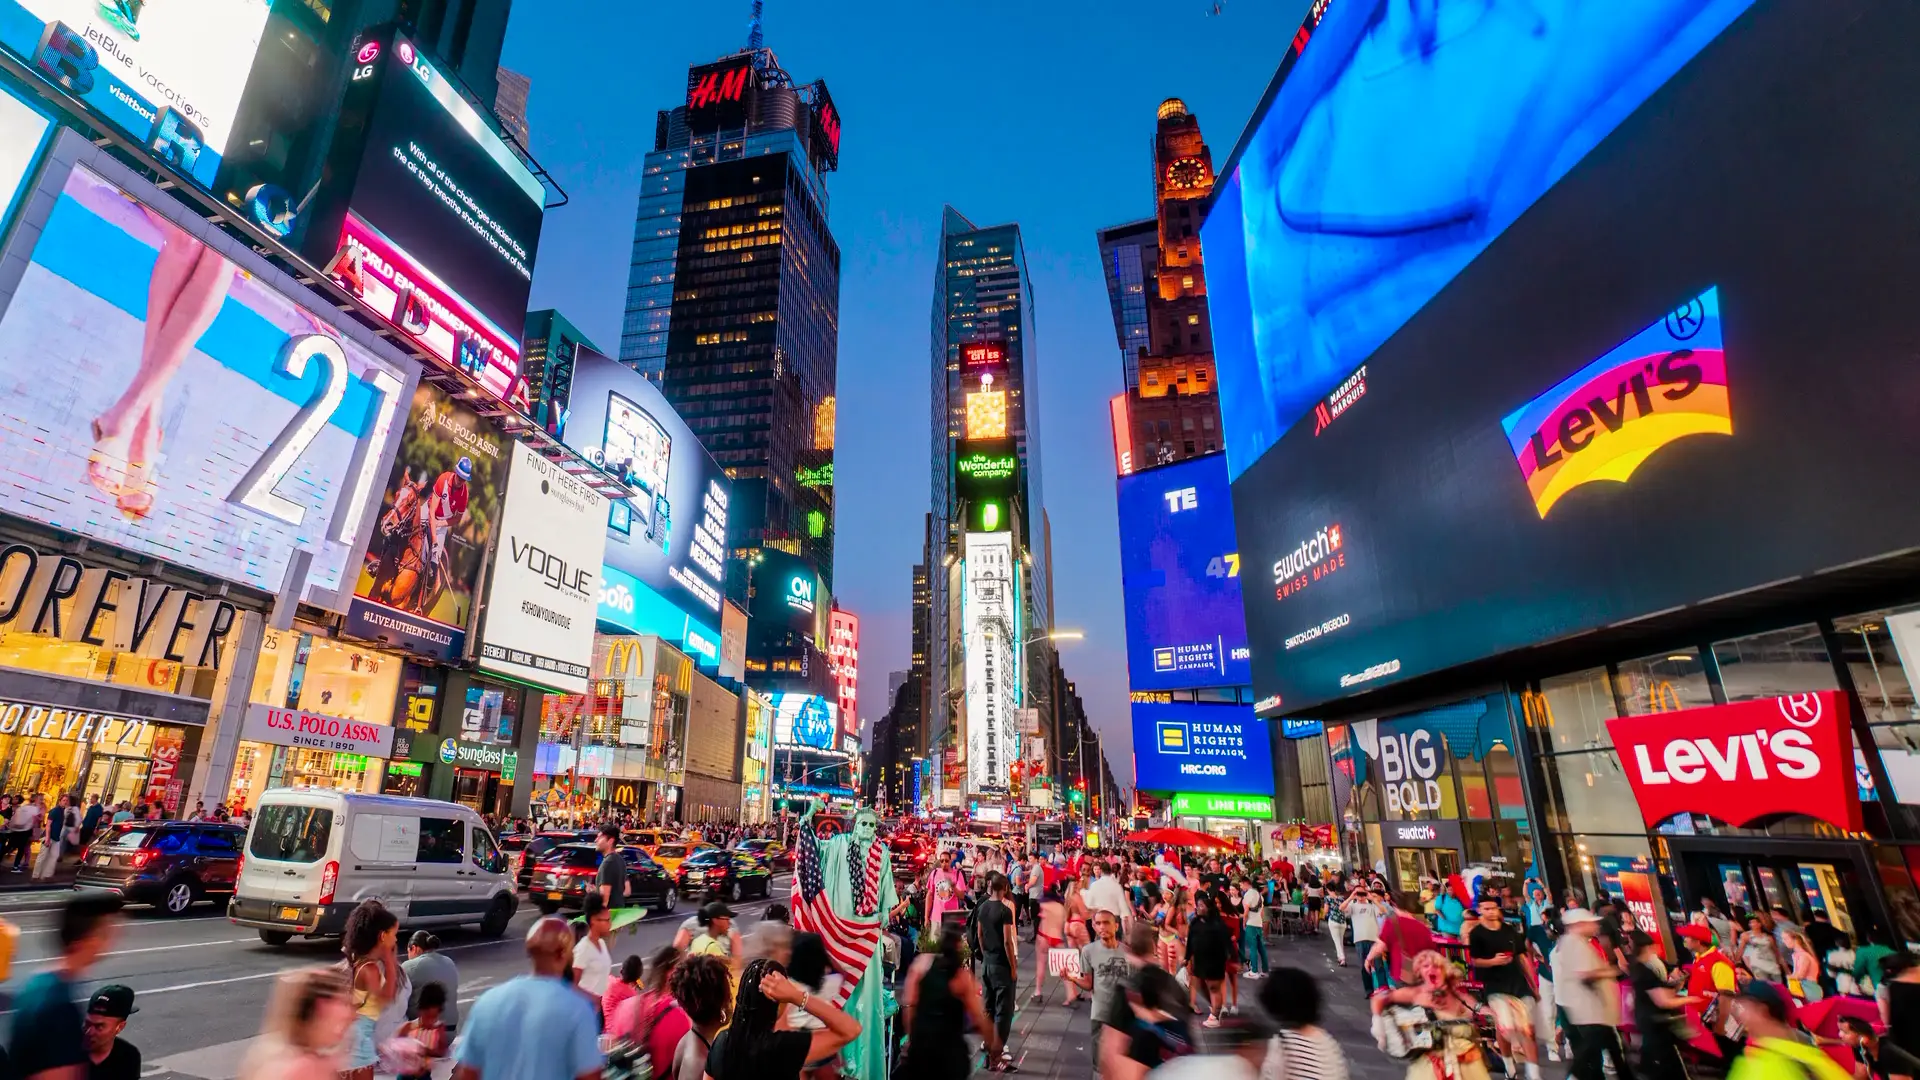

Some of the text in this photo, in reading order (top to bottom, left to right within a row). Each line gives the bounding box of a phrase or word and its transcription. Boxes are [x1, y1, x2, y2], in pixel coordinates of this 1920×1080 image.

[82, 22, 210, 128] jetBlue vacations
[353, 65, 374, 81] LG
[412, 56, 430, 82] LG
[689, 65, 748, 109] H&M
[820, 102, 840, 155] H&M
[394, 146, 408, 166] the
[407, 159, 420, 176] air
[417, 168, 435, 192] they
[434, 182, 462, 216] breathe
[460, 209, 491, 241] shouldn't
[488, 234, 499, 251] be
[497, 244, 512, 261] one
[509, 253, 519, 266] of
[409, 141, 528, 261] With all of the challenges children face,
[1330, 366, 1367, 405] MARRIOTT
[1332, 382, 1366, 418] MARQUIS
[241, 334, 404, 548] 21
[438, 412, 500, 460] U.S. POLO ASSN.
[453, 436, 470, 451] SINCE
[960, 457, 1014, 471] Wonderful
[973, 454, 986, 462] the
[526, 453, 601, 508] FIND IT HERE FIRST
[550, 487, 575, 509] sunglass
[1165, 487, 1198, 513] TE
[1205, 553, 1240, 579] 47
[1273, 526, 1331, 585] swatch
[791, 576, 811, 602] ON
[1276, 553, 1345, 601] SWISS MADE
[521, 600, 572, 630] #SHOWYOURVOGUE
[363, 610, 453, 647] #LIVEAUTHENTICALLY
[834, 629, 852, 641] THE
[1285, 613, 1350, 650] SWATCH.COM/BIGBOLD
[263, 635, 278, 649] 25
[483, 644, 506, 660] EYEWEAR
[1177, 643, 1213, 654] HUMAN
[365, 659, 379, 675] $30
[1178, 652, 1214, 663] RIGHTS
[1179, 662, 1215, 670] CAMPAIGN
[117, 718, 149, 746] 21
[267, 710, 381, 744] U.S. POLO ASSN.
[1192, 723, 1242, 734] HUMAN
[293, 735, 355, 751] SINCE 1890
[1193, 736, 1243, 746] RIGHTS
[1194, 748, 1244, 757] CAMPAIGN
[457, 744, 501, 767] sunglass
[1379, 729, 1437, 782] BIG
[147, 746, 178, 798] SALE
[1180, 764, 1227, 775] HRC.ORG
[1208, 800, 1235, 811] LINE
[1386, 779, 1442, 812] BOLD
[1398, 825, 1430, 840] swatch
[1627, 900, 1653, 914] SALE
[1050, 951, 1080, 973] HUGS
